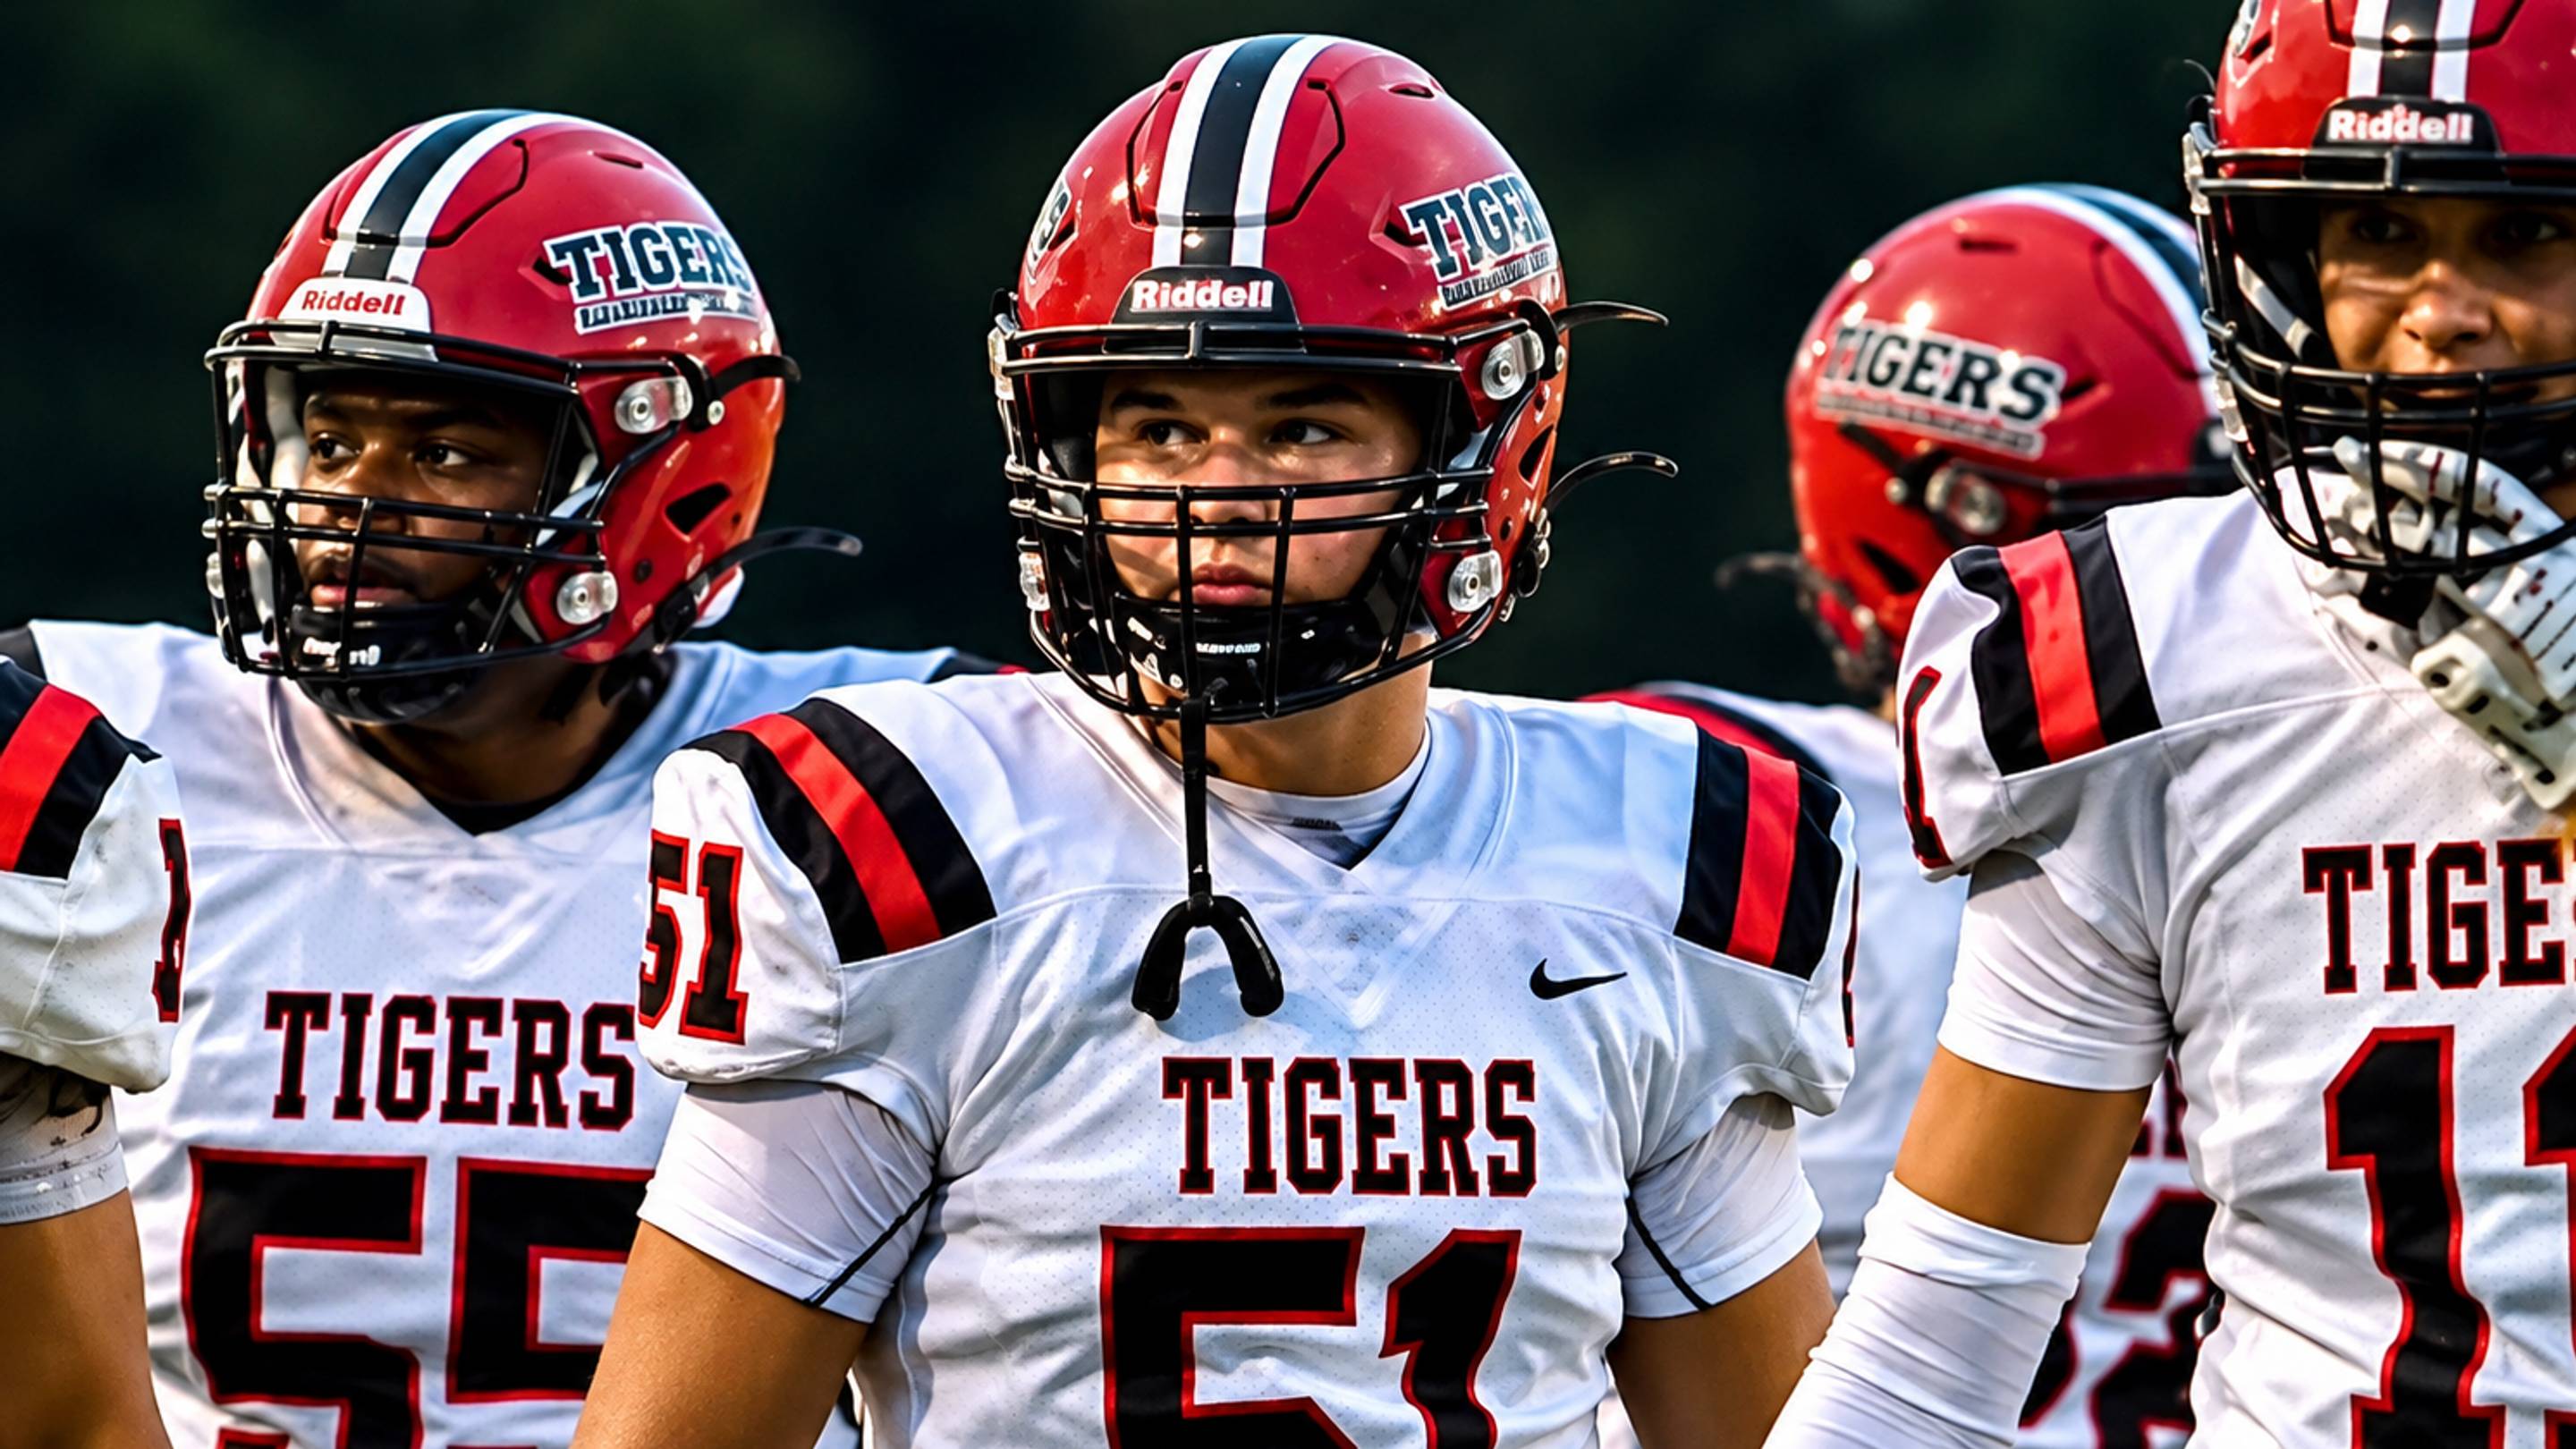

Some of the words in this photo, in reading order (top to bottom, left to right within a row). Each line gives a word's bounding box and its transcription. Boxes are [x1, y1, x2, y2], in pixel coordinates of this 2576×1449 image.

[2327, 107, 2474, 142] Riddell
[301, 281, 405, 316] Riddell
[547, 225, 754, 300] TIGERS
[1131, 279, 1275, 311] Riddell
[1822, 326, 2058, 423] TIGERS
[638, 828, 750, 1046] 51
[2301, 837, 2576, 995] TIGE
[265, 989, 636, 1132] TIGERS
[1161, 1056, 1537, 1199] TIGERS
[1099, 1224, 1523, 1449] 51
